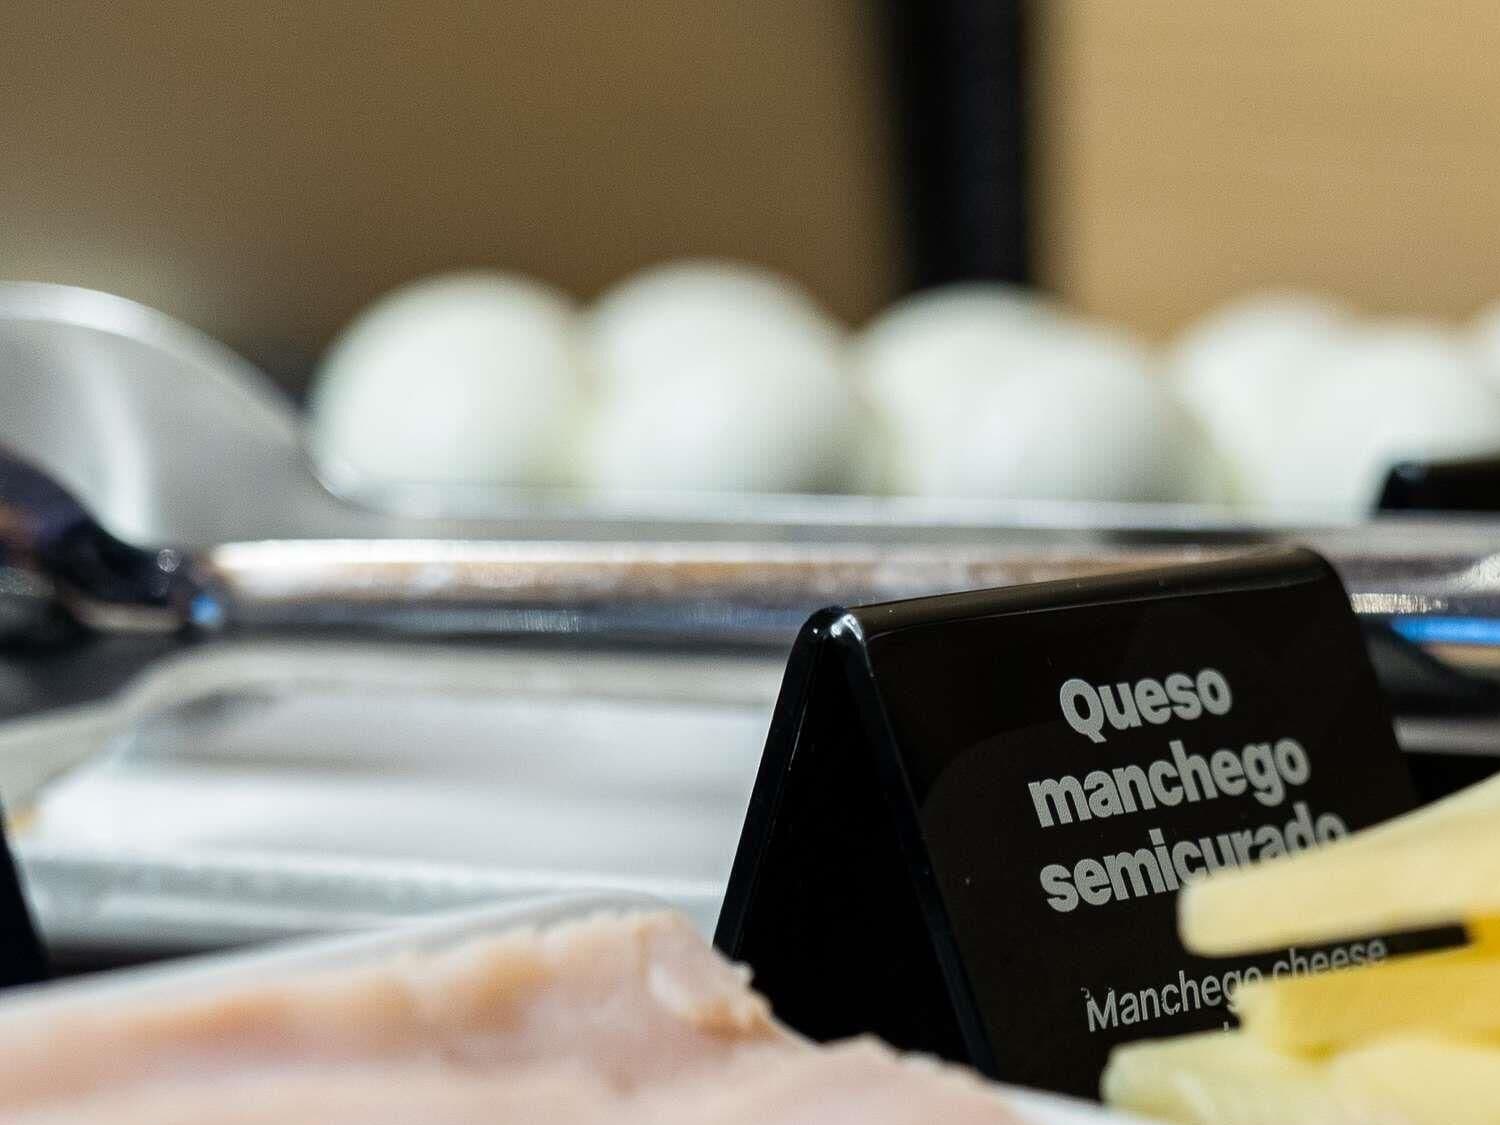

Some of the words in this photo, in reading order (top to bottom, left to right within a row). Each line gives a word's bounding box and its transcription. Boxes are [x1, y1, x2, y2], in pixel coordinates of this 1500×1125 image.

[1059, 667, 1232, 743] Queso
[1027, 738, 1311, 828] manchego
[1039, 803, 1348, 912] semicurado
[1084, 966, 1264, 1032] Manchego
[1272, 939, 1389, 981] cheese
